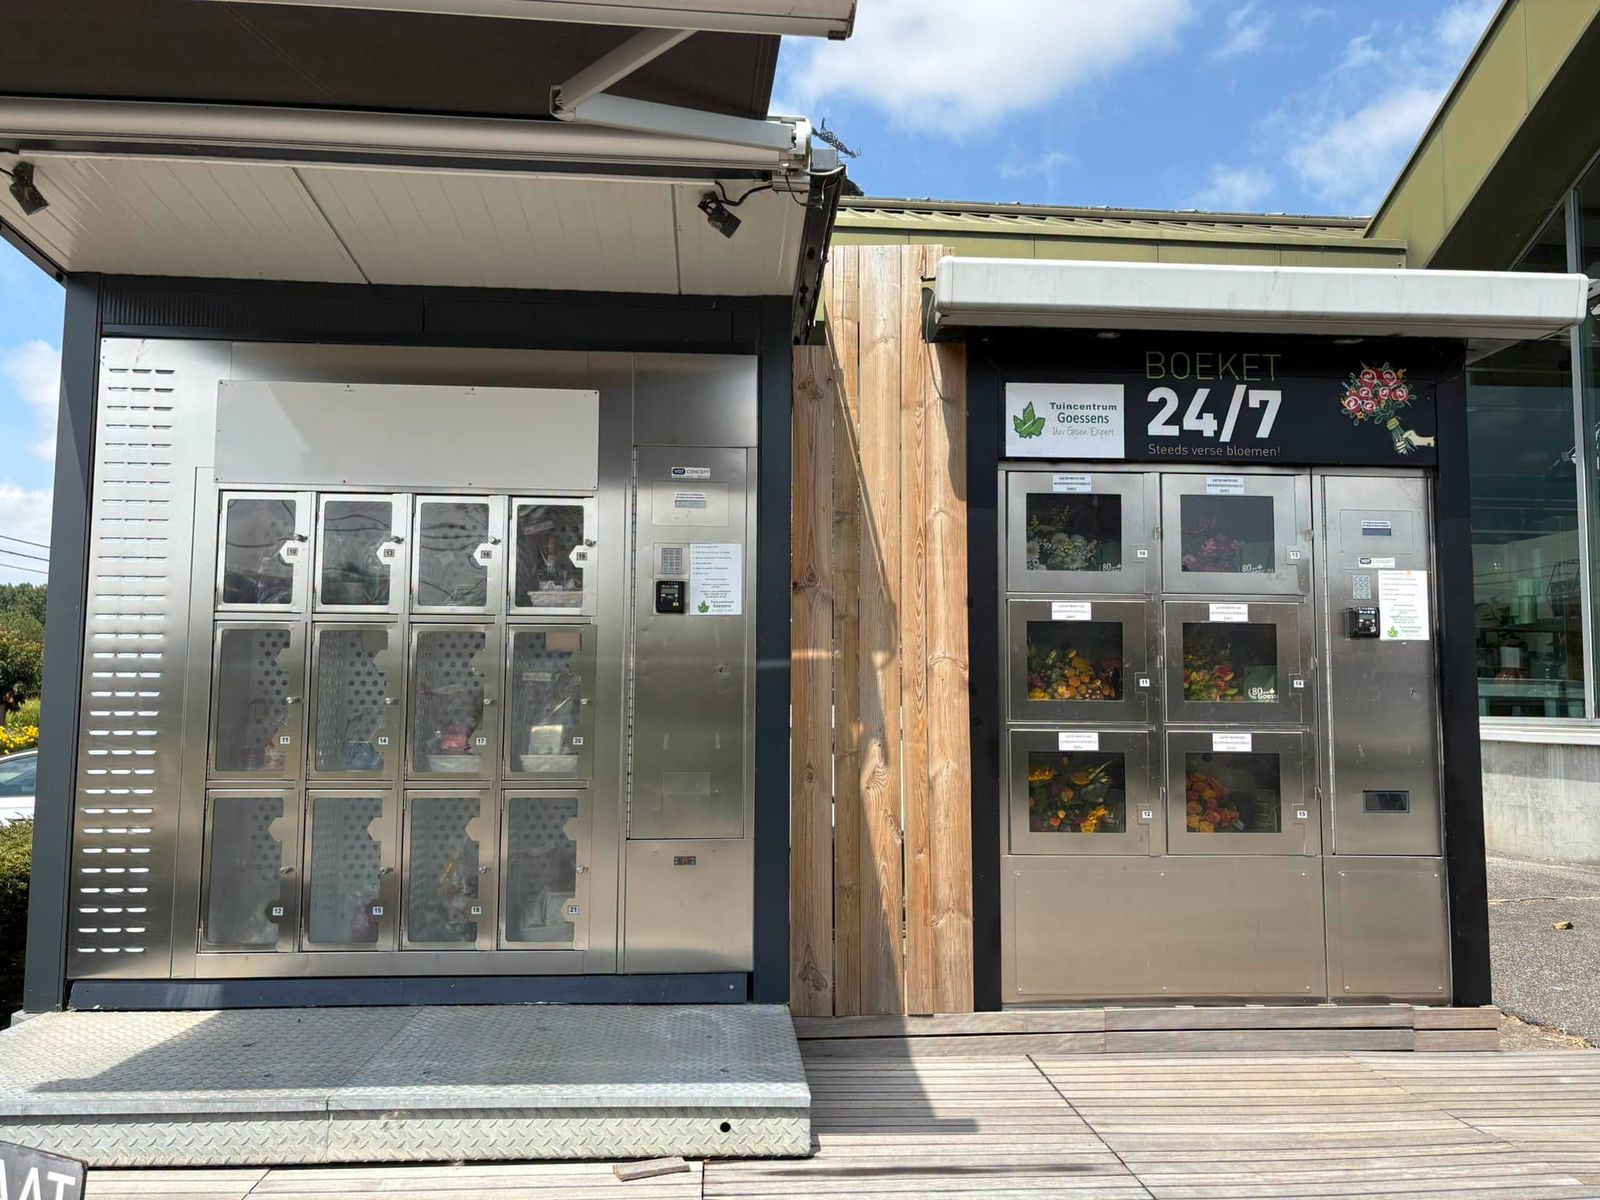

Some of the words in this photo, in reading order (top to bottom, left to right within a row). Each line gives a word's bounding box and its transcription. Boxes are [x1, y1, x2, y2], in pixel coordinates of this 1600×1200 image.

[1146, 351, 1282, 381] BOEKET
[1049, 402, 1117, 411] Tuincentrum
[1147, 384, 1282, 442] 24/7
[1057, 412, 1109, 424] Goessens
[1090, 427, 1114, 439] Expert
[1148, 443, 1188, 455] Steeds
[1192, 446, 1223, 456] verse
[1226, 445, 1281, 457] bloemen!
[1252, 687, 1262, 695] 80
[0, 1159, 76, 1200] AT
